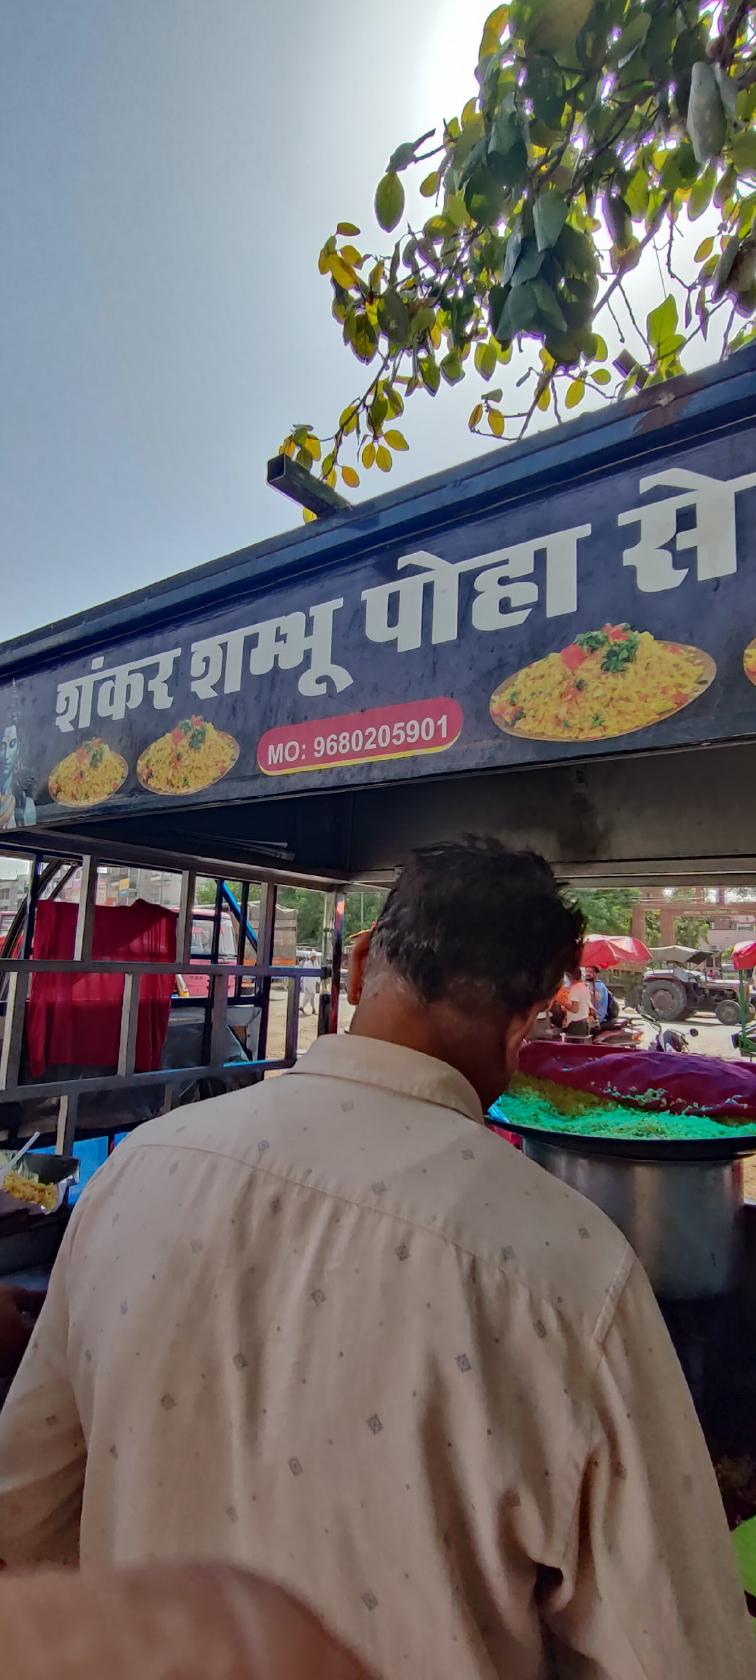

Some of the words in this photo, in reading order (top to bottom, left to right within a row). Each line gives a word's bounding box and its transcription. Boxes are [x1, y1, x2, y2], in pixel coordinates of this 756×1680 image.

[55, 657, 182, 733] शंकर
[191, 598, 354, 699] शम्भू
[361, 523, 591, 652] पोहा
[268, 740, 306, 765] MO:
[314, 715, 448, 758] 9680205901
